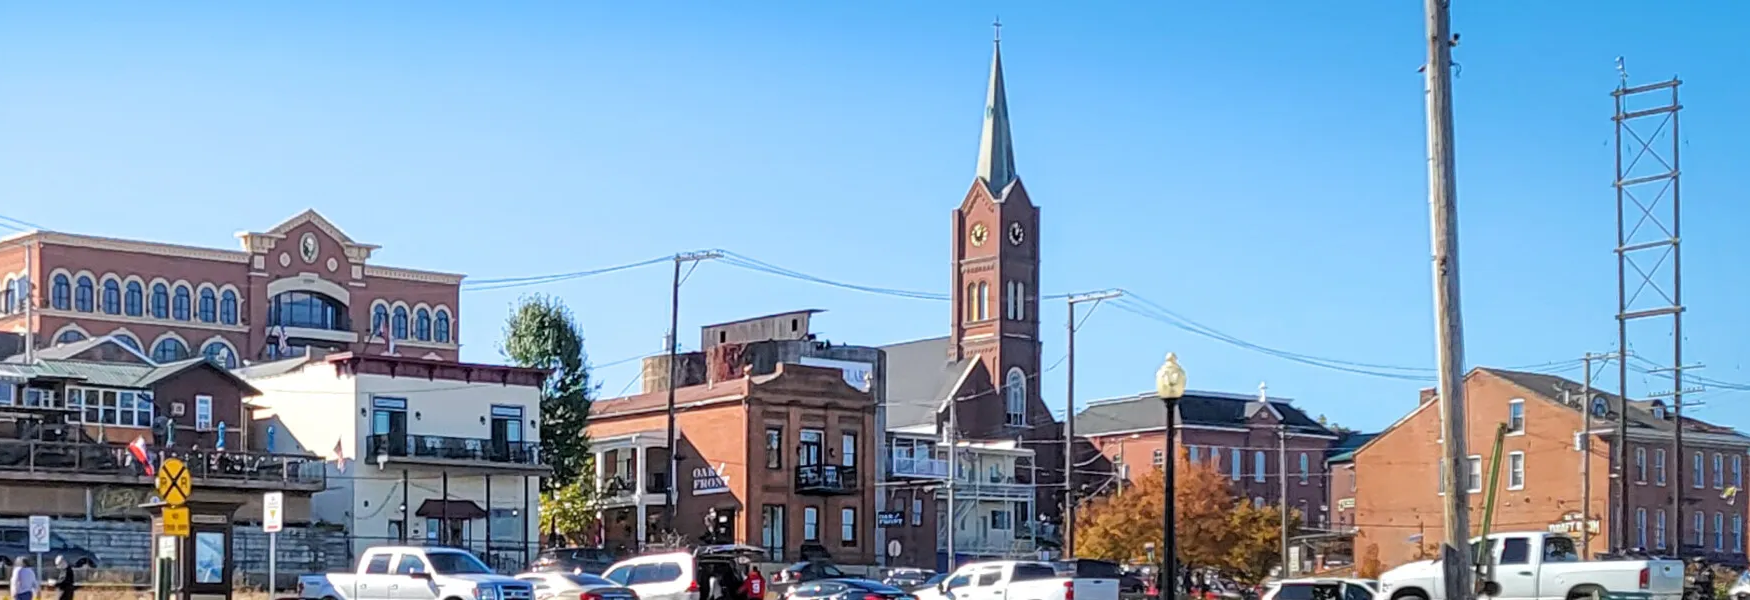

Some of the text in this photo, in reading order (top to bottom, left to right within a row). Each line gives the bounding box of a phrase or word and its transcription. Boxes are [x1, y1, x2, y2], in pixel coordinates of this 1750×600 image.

[692, 467, 716, 478] OAK
[180, 476, 187, 488] R
[693, 475, 730, 489] FRONT
